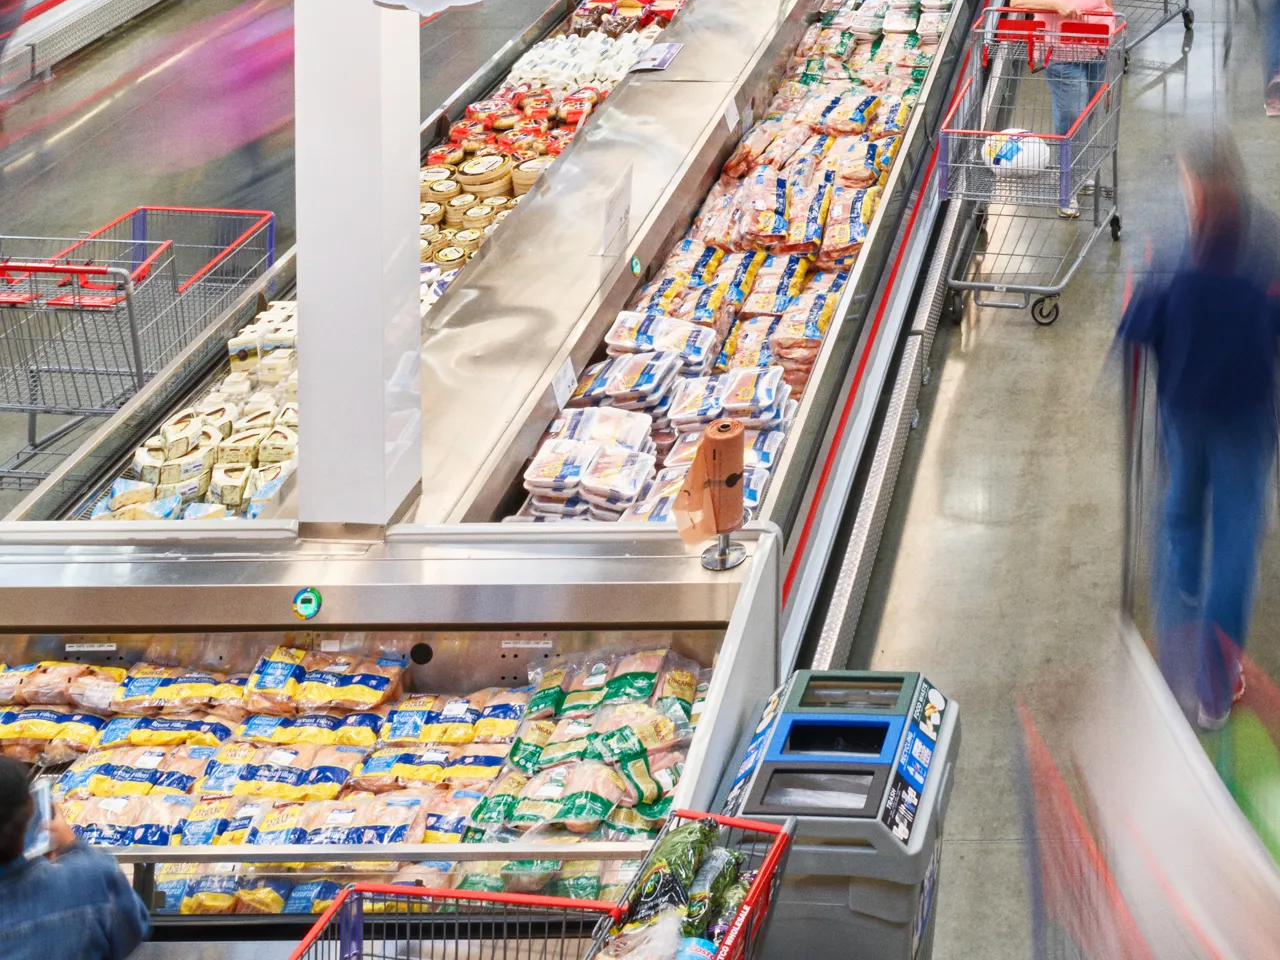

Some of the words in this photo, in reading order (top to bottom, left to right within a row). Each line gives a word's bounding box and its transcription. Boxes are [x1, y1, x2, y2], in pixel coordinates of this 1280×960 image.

[914, 701, 922, 720] FOOD
[919, 682, 929, 702] WASTE
[901, 731, 914, 766] RECYCLING
[886, 788, 896, 810] TRASH
[724, 904, 751, 946] WHOLESALE
